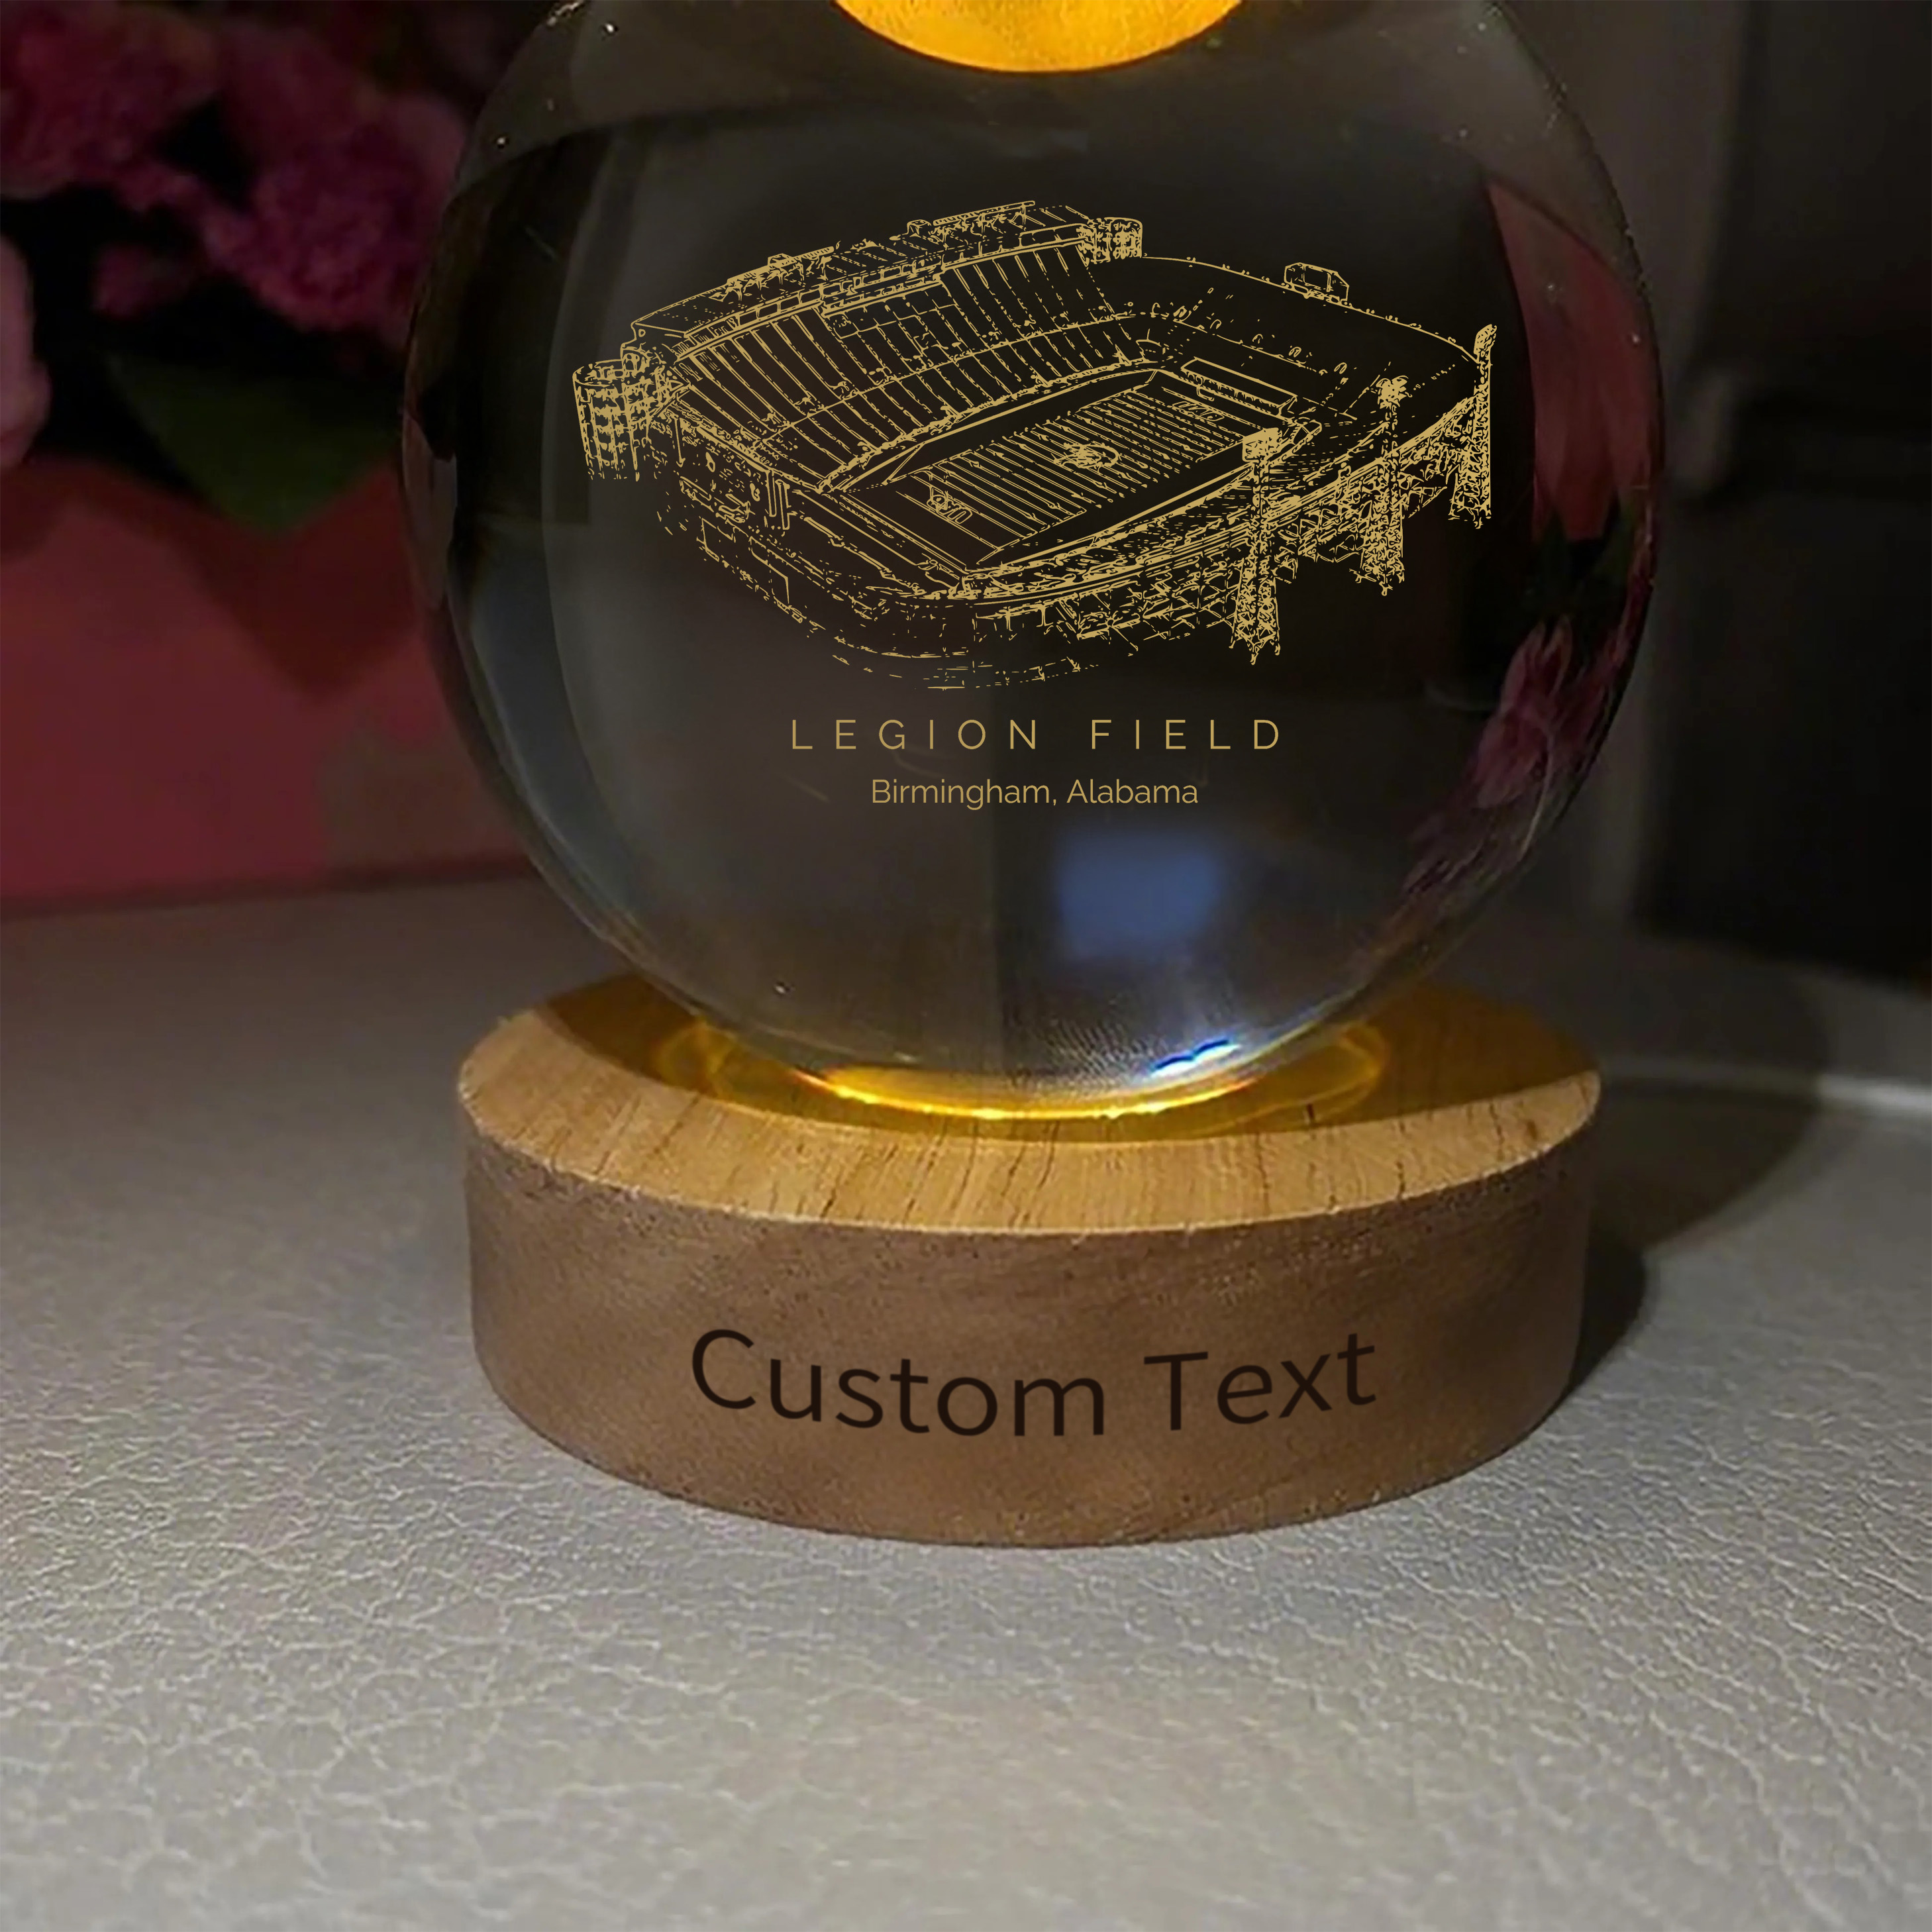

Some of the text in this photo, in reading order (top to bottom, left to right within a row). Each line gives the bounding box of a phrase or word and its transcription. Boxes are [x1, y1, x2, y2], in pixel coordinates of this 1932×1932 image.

[792, 719, 1280, 750] LEGION FIELD
[872, 778, 1198, 811] Birmingham, Alabama
[691, 1329, 1377, 1437] Custom Text
